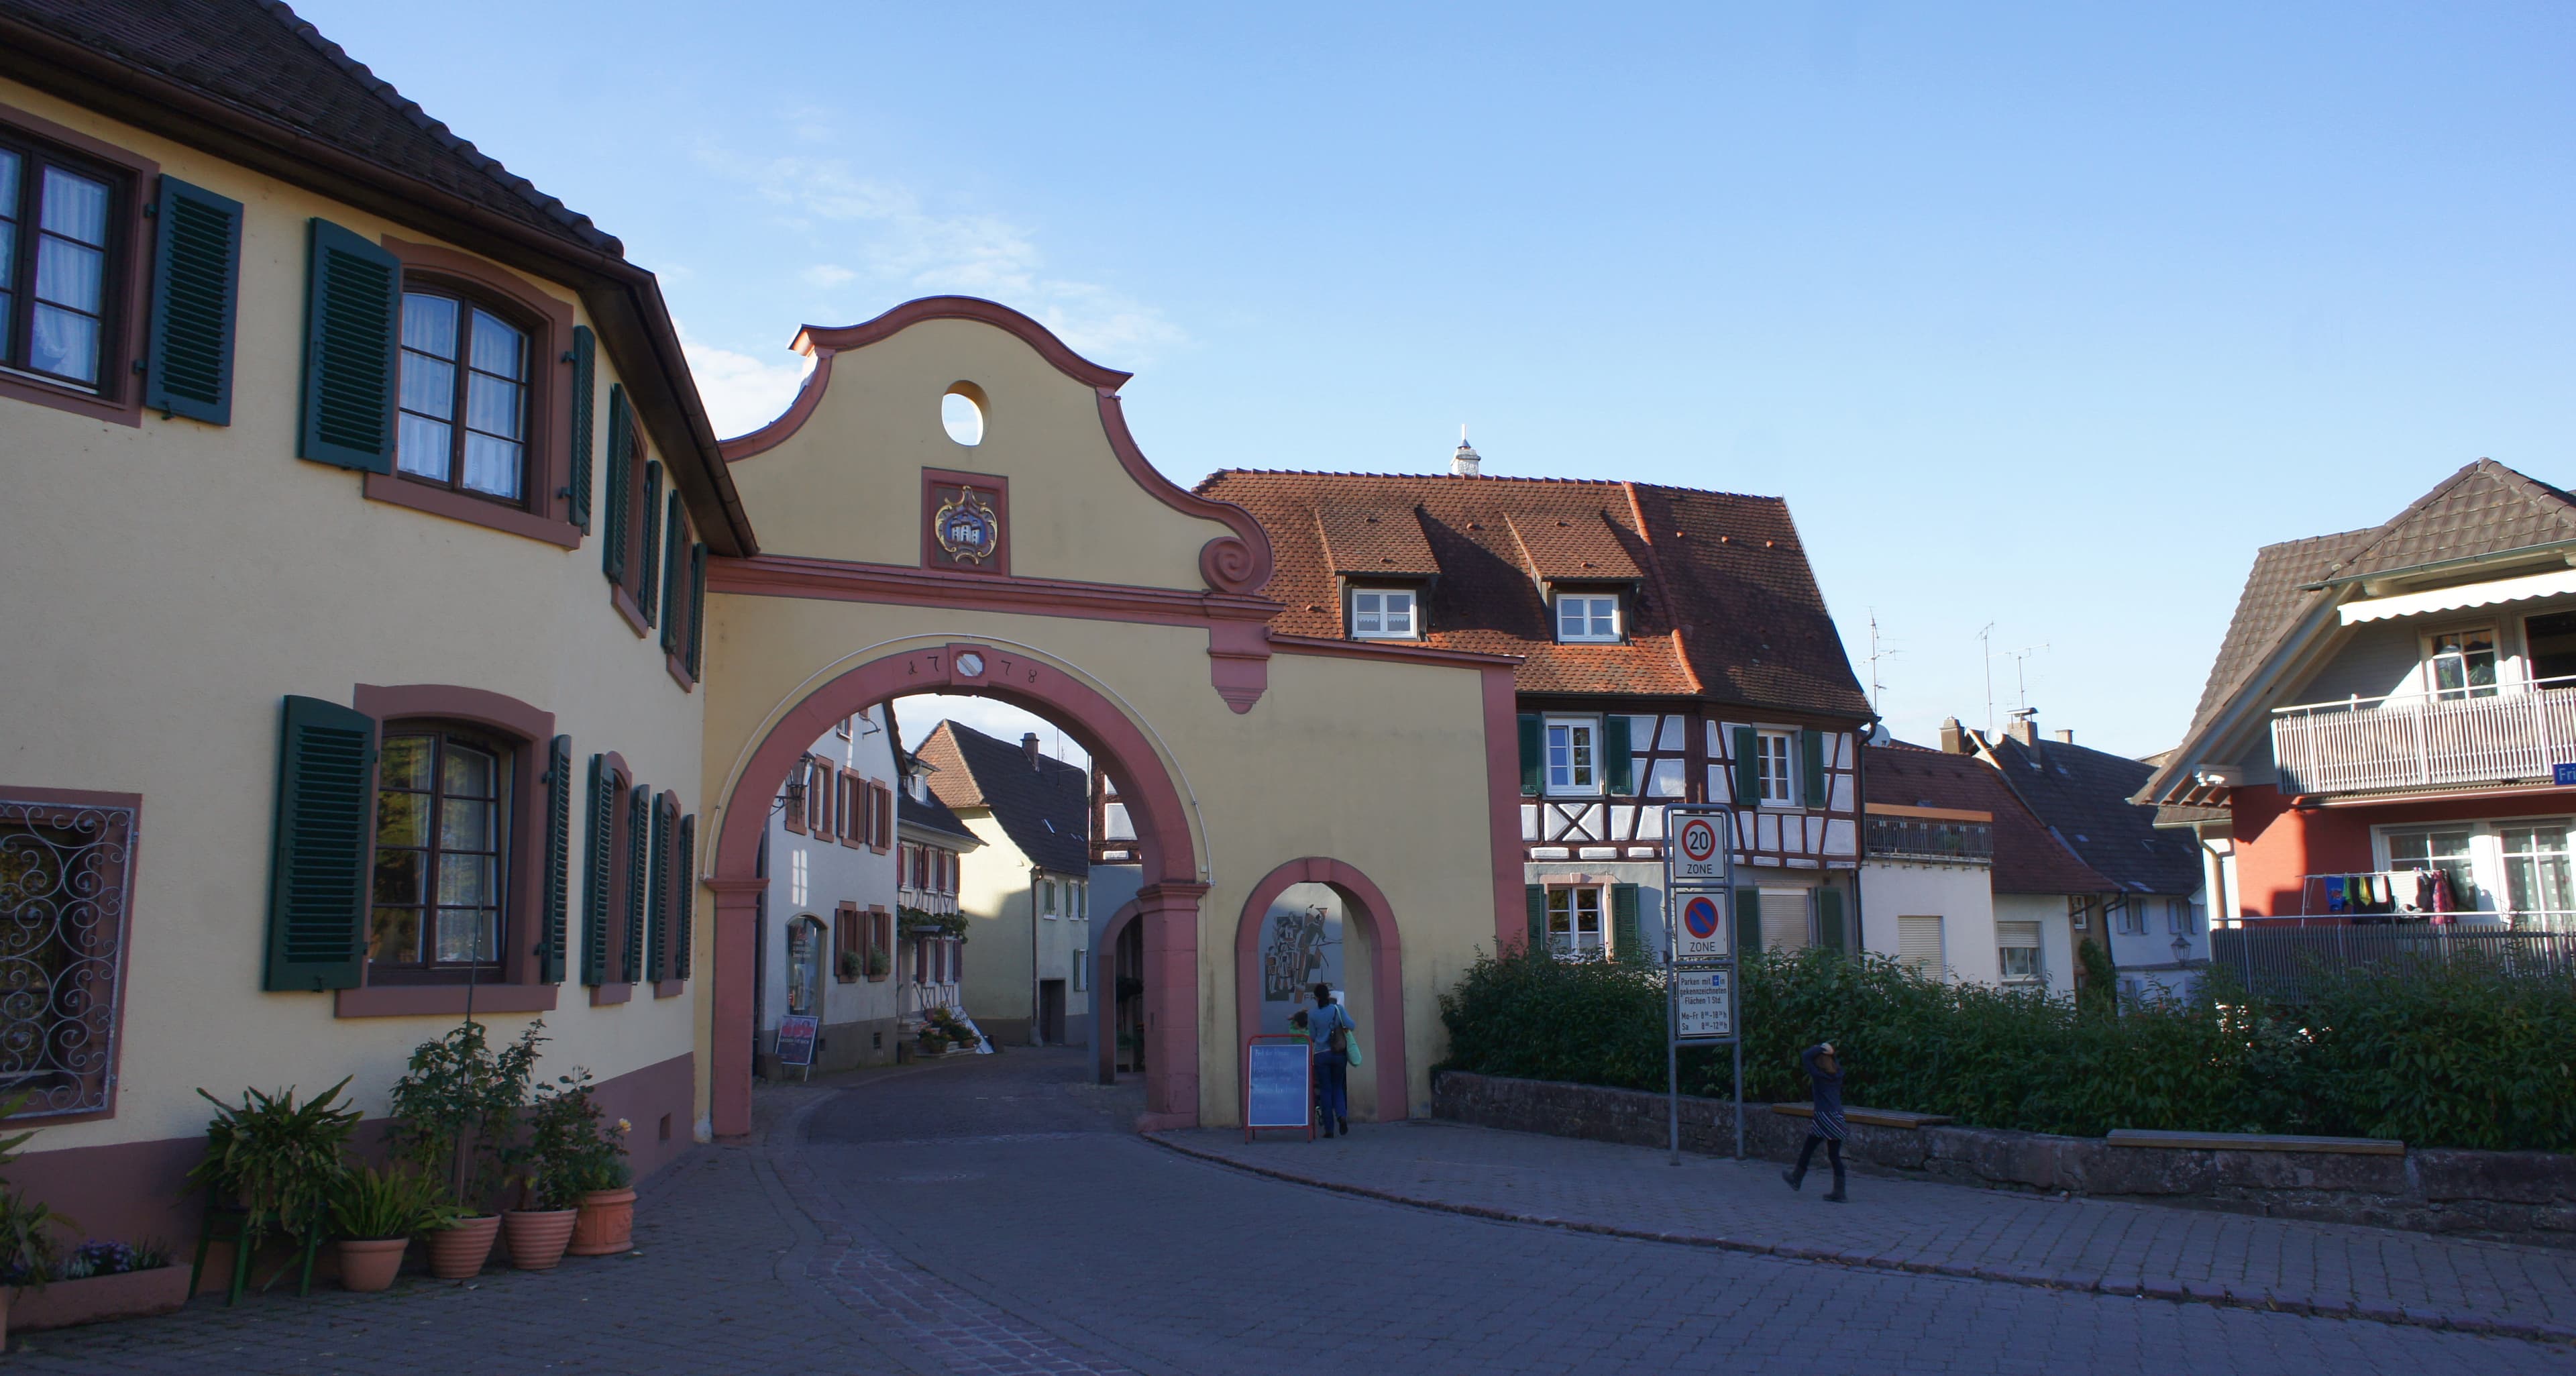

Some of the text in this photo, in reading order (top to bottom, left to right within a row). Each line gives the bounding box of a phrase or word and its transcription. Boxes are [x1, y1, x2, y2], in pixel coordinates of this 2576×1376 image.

[1689, 831, 1709, 850] 20
[1686, 864, 1712, 874] ZONE
[1690, 942, 1715, 952] ZONE
[1680, 977, 1699, 986] Parken
[1701, 977, 1711, 986] mit
[1679, 988, 1727, 997] gekennzeichneten
[1684, 996, 1706, 1004] Flächen
[1708, 996, 1710, 1004] 1
[1681, 1011, 1698, 1020] Mo-Fr
[1682, 1022, 1689, 1030] Sa
